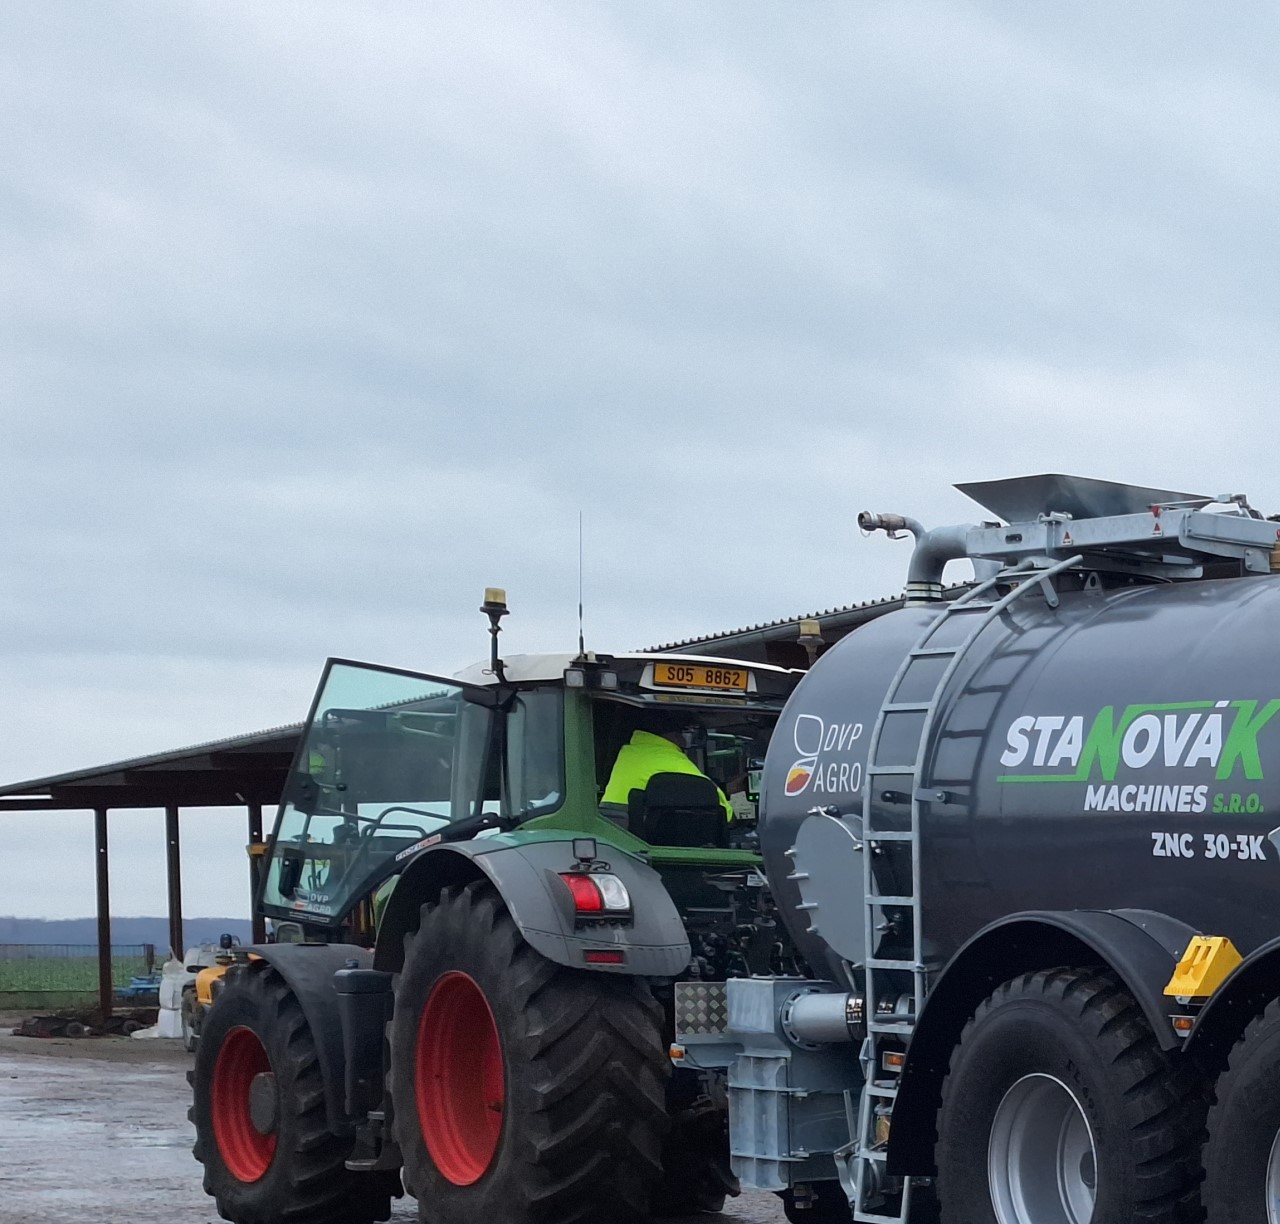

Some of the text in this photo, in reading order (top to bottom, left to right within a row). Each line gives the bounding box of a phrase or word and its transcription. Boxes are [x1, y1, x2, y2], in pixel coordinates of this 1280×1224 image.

[705, 670, 740, 687] 8862
[823, 723, 863, 751] DVP
[813, 762, 861, 793] AGRO
[1084, 785, 1265, 815] MACHINES S.R.O.
[1151, 832, 1266, 861] ZNC 30-3K
